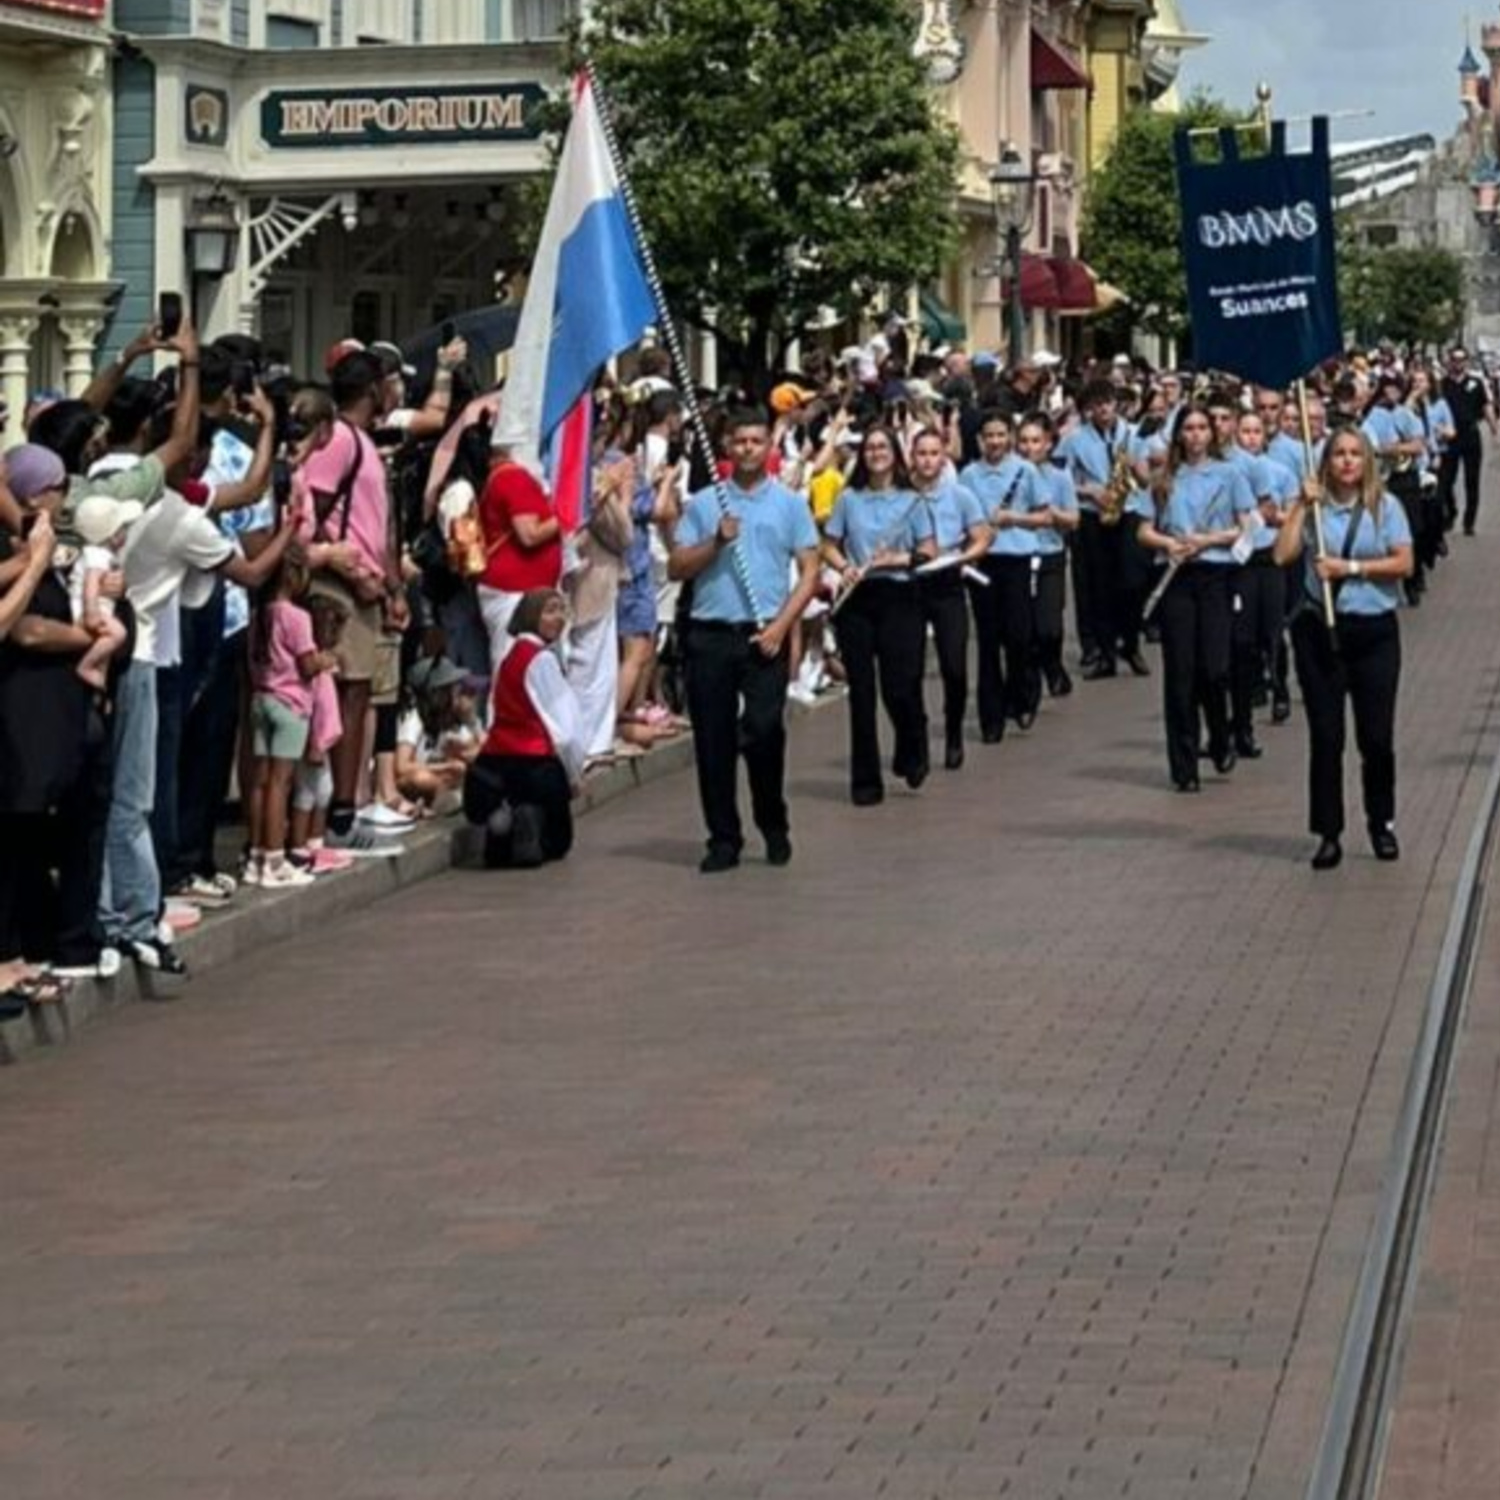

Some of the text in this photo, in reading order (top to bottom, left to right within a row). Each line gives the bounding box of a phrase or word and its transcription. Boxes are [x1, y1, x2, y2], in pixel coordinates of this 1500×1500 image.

[280, 93, 524, 136] EMPORIUM
[1198, 199, 1318, 248] BMMS
[1220, 291, 1309, 318] Suances
